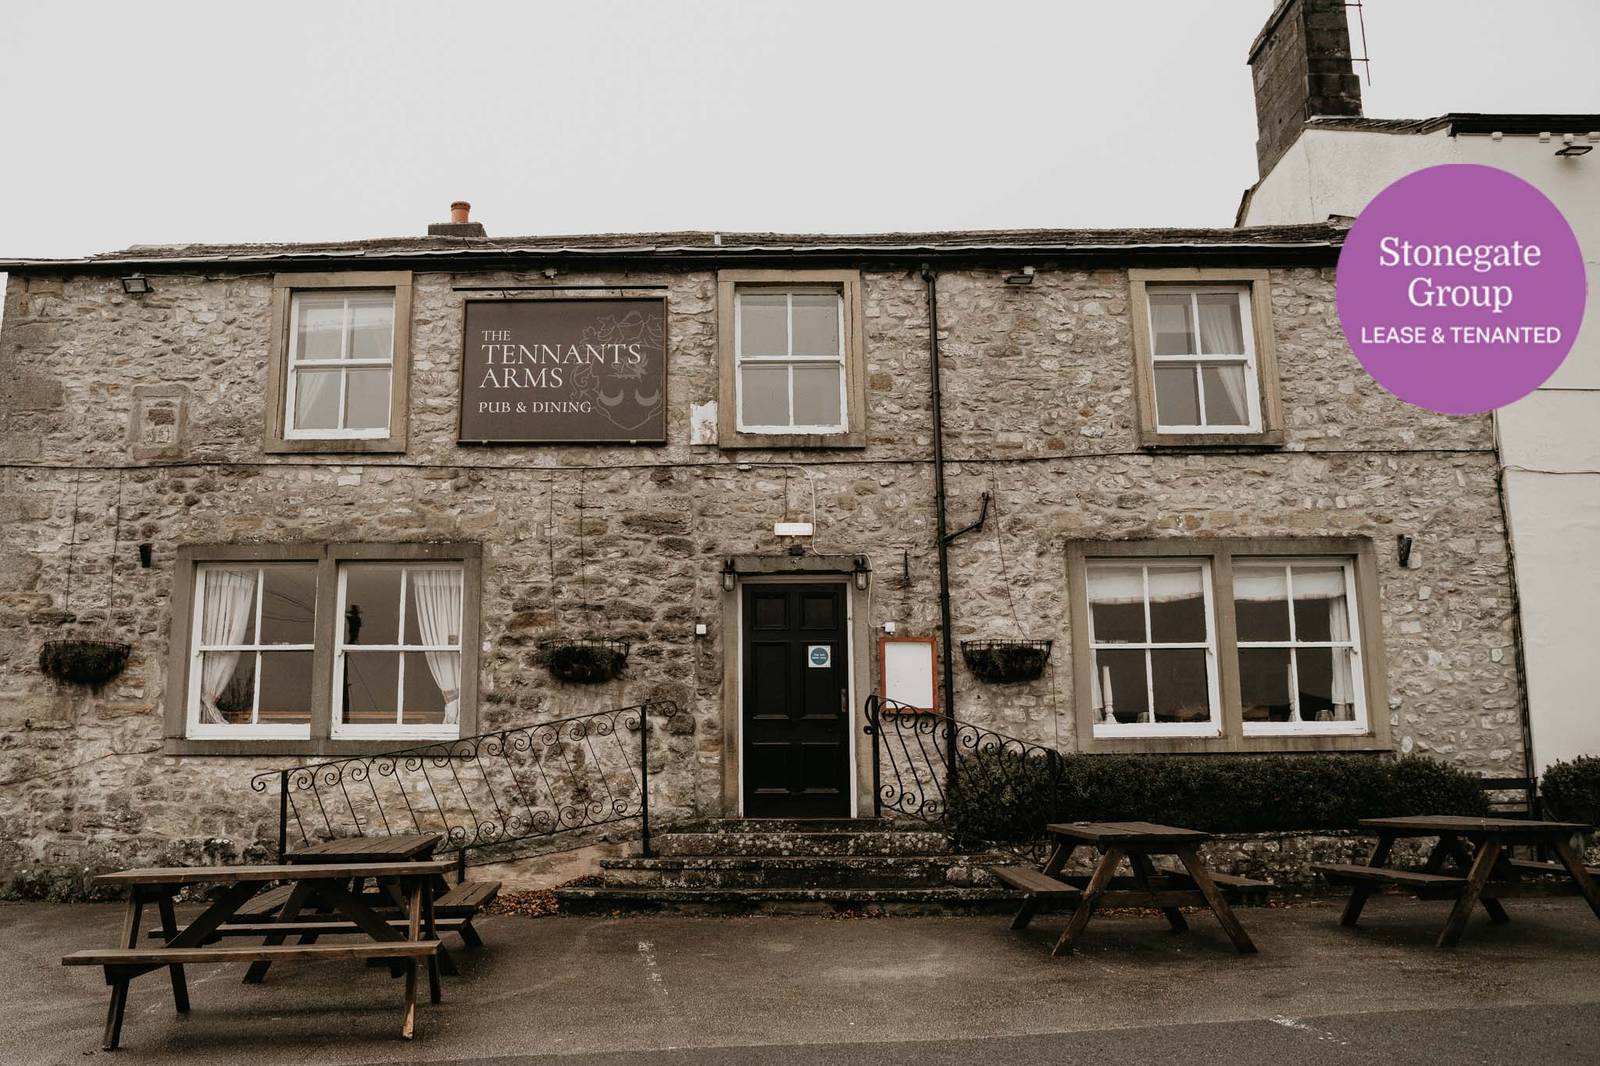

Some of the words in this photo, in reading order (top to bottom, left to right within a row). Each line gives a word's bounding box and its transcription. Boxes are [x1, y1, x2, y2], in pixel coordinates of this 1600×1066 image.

[482, 330, 510, 341] THE
[481, 343, 641, 365] TENNANTS
[479, 367, 563, 389] ARMS
[479, 402, 511, 413] PUB
[516, 402, 527, 413] &
[533, 402, 592, 413] DINING
